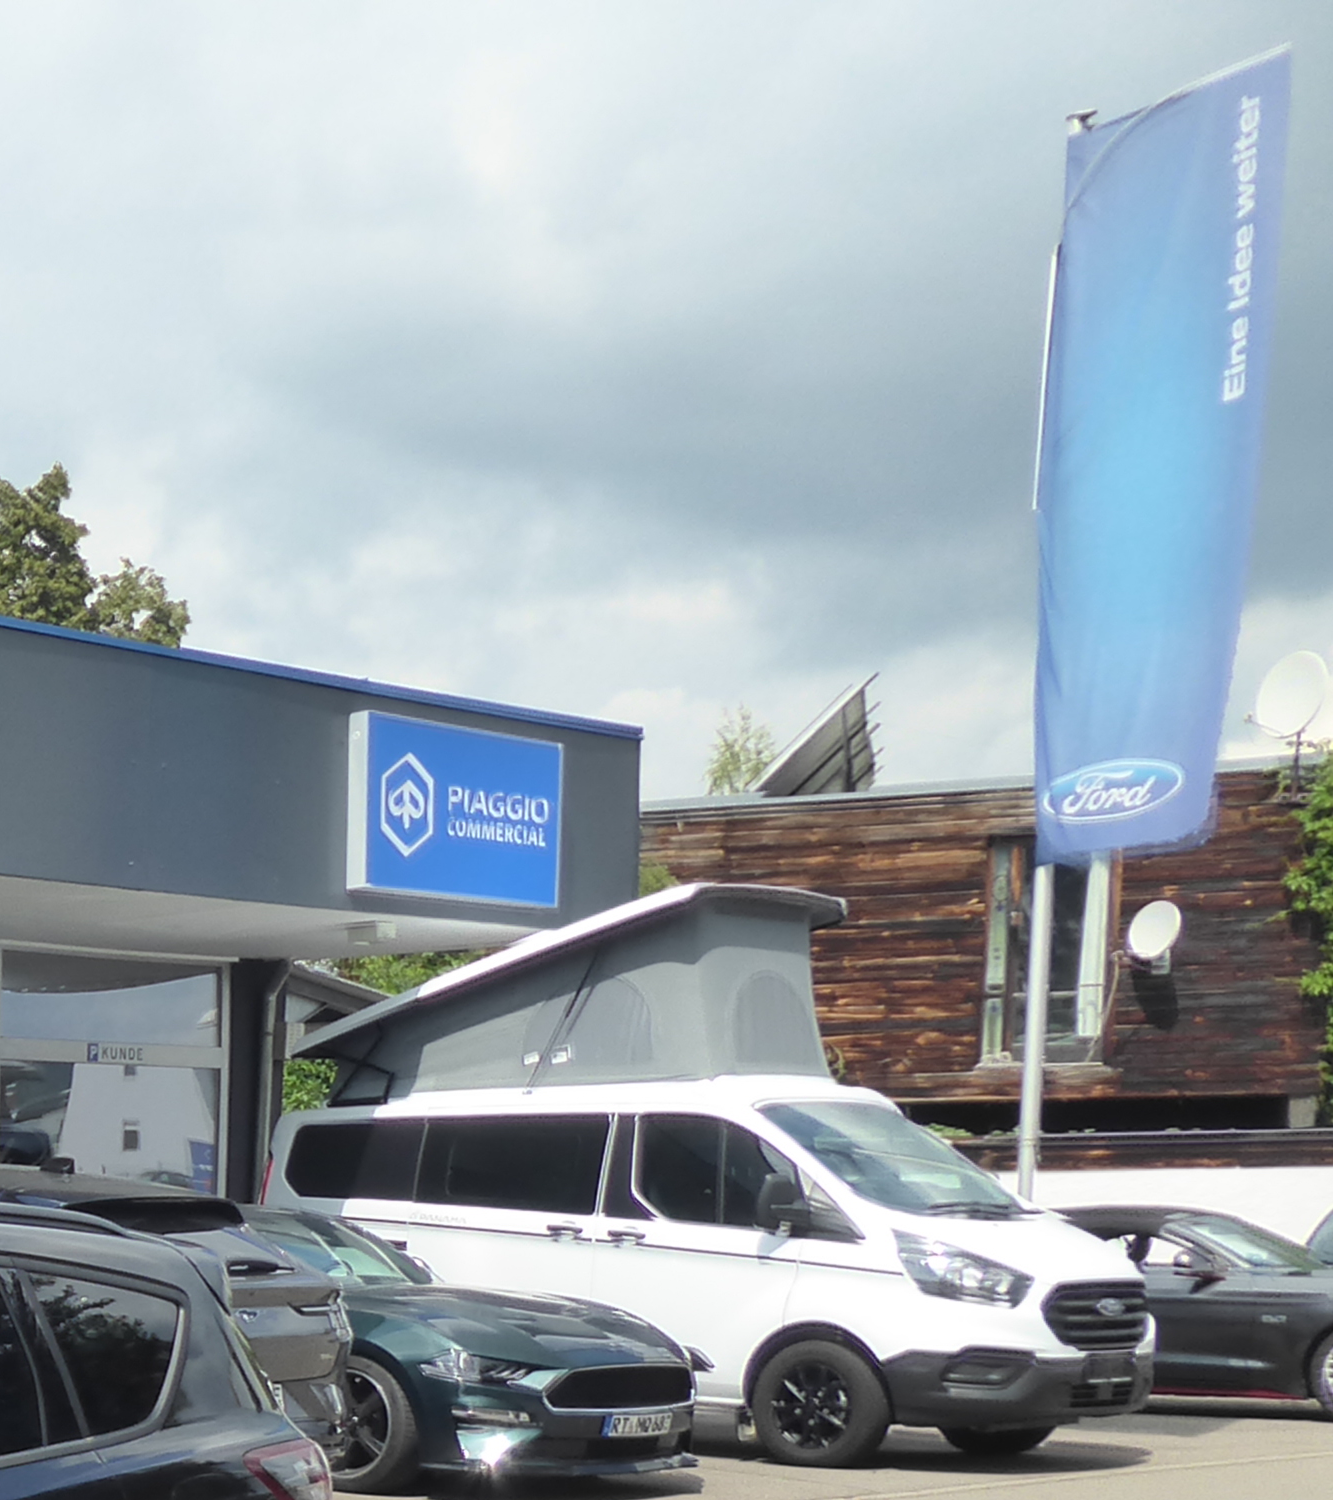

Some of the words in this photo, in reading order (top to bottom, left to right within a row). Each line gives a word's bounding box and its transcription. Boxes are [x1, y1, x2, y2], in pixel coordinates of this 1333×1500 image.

[1231, 95, 1261, 220] weiter
[1227, 223, 1254, 311] Idee
[1222, 316, 1249, 403] Eine
[447, 785, 549, 825] PIAGGIO
[1062, 769, 1158, 815] Ford
[447, 816, 546, 847] COMMERCIAL
[101, 1046, 143, 1061] KUNDE
